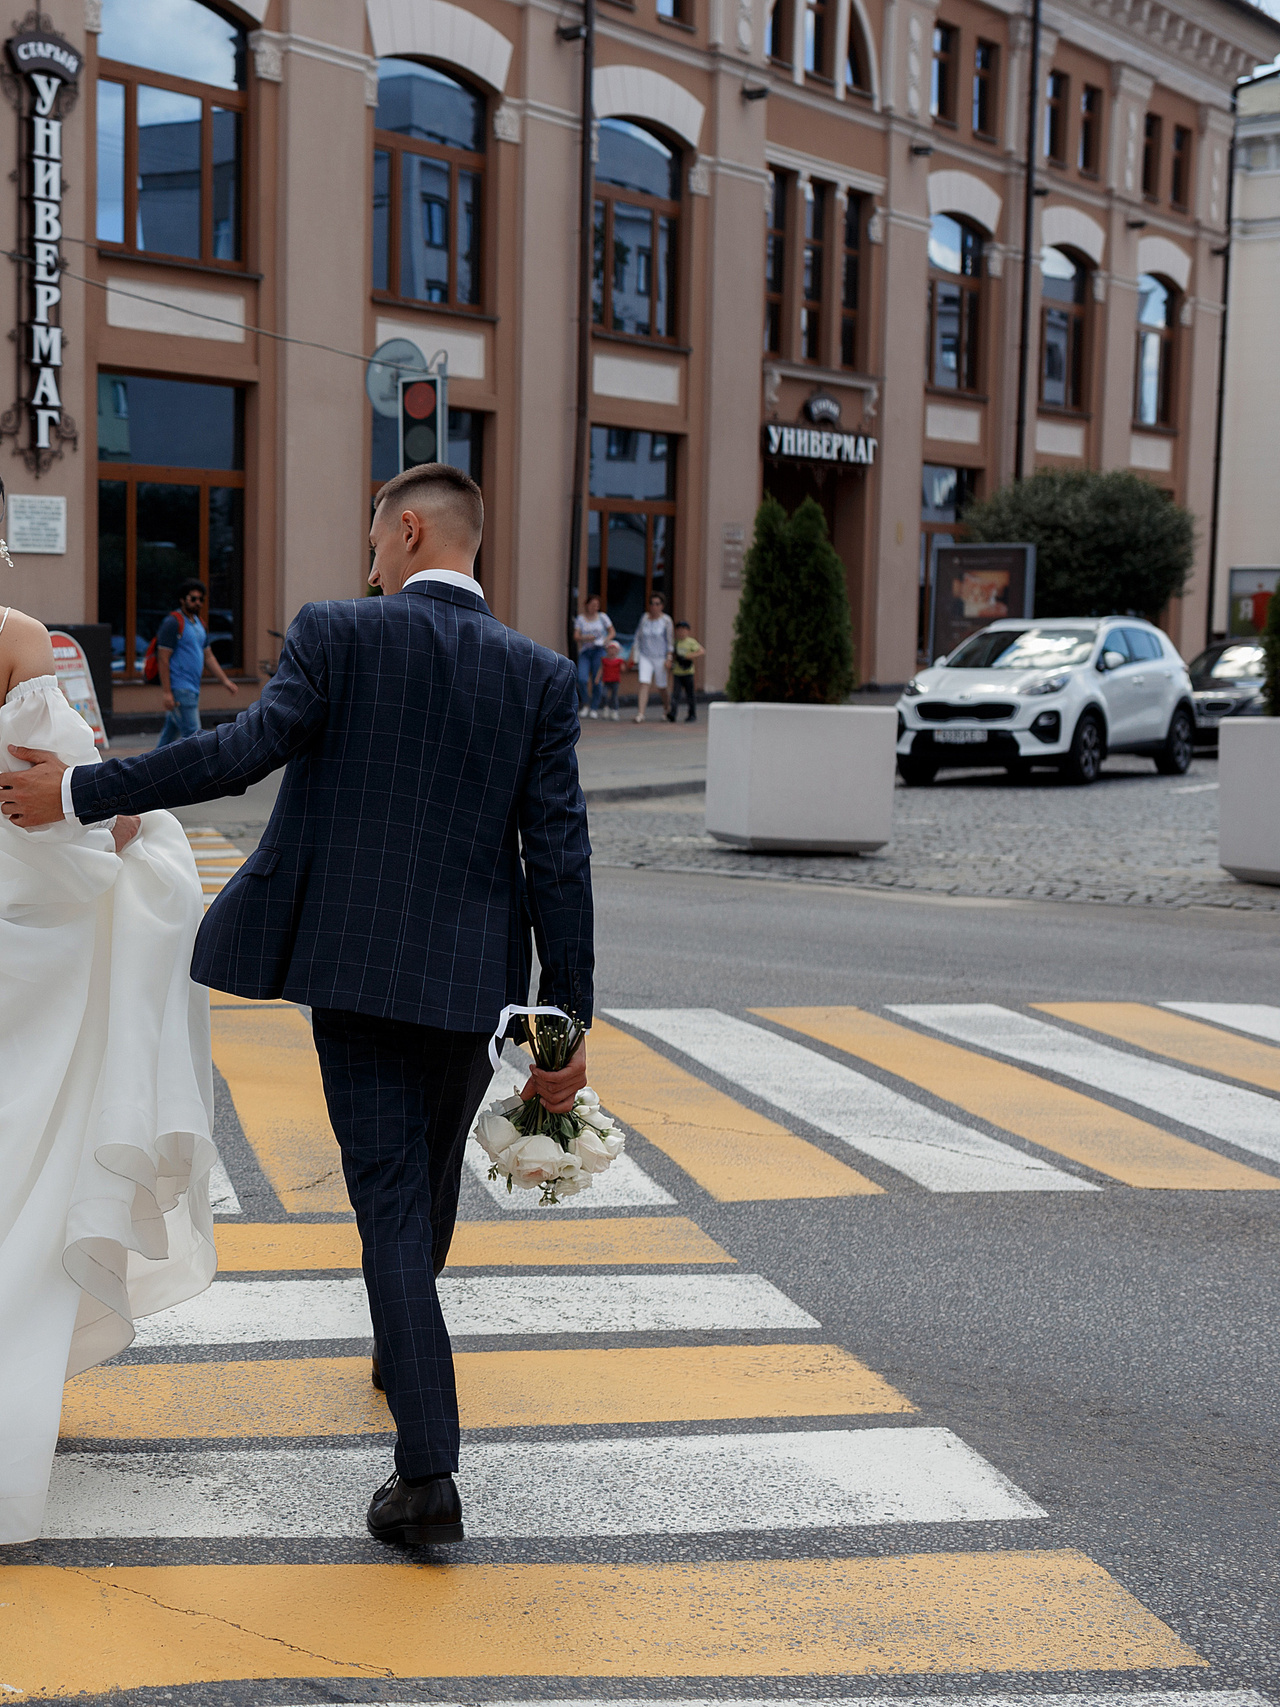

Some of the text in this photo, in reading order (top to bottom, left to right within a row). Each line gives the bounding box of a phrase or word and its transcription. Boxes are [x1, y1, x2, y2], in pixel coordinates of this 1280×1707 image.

[17, 41, 79, 73] СТАРЫЙ
[31, 74, 63, 448] УНИВЕРМАГ
[767, 424, 878, 465] УНИВЕРМАГ
